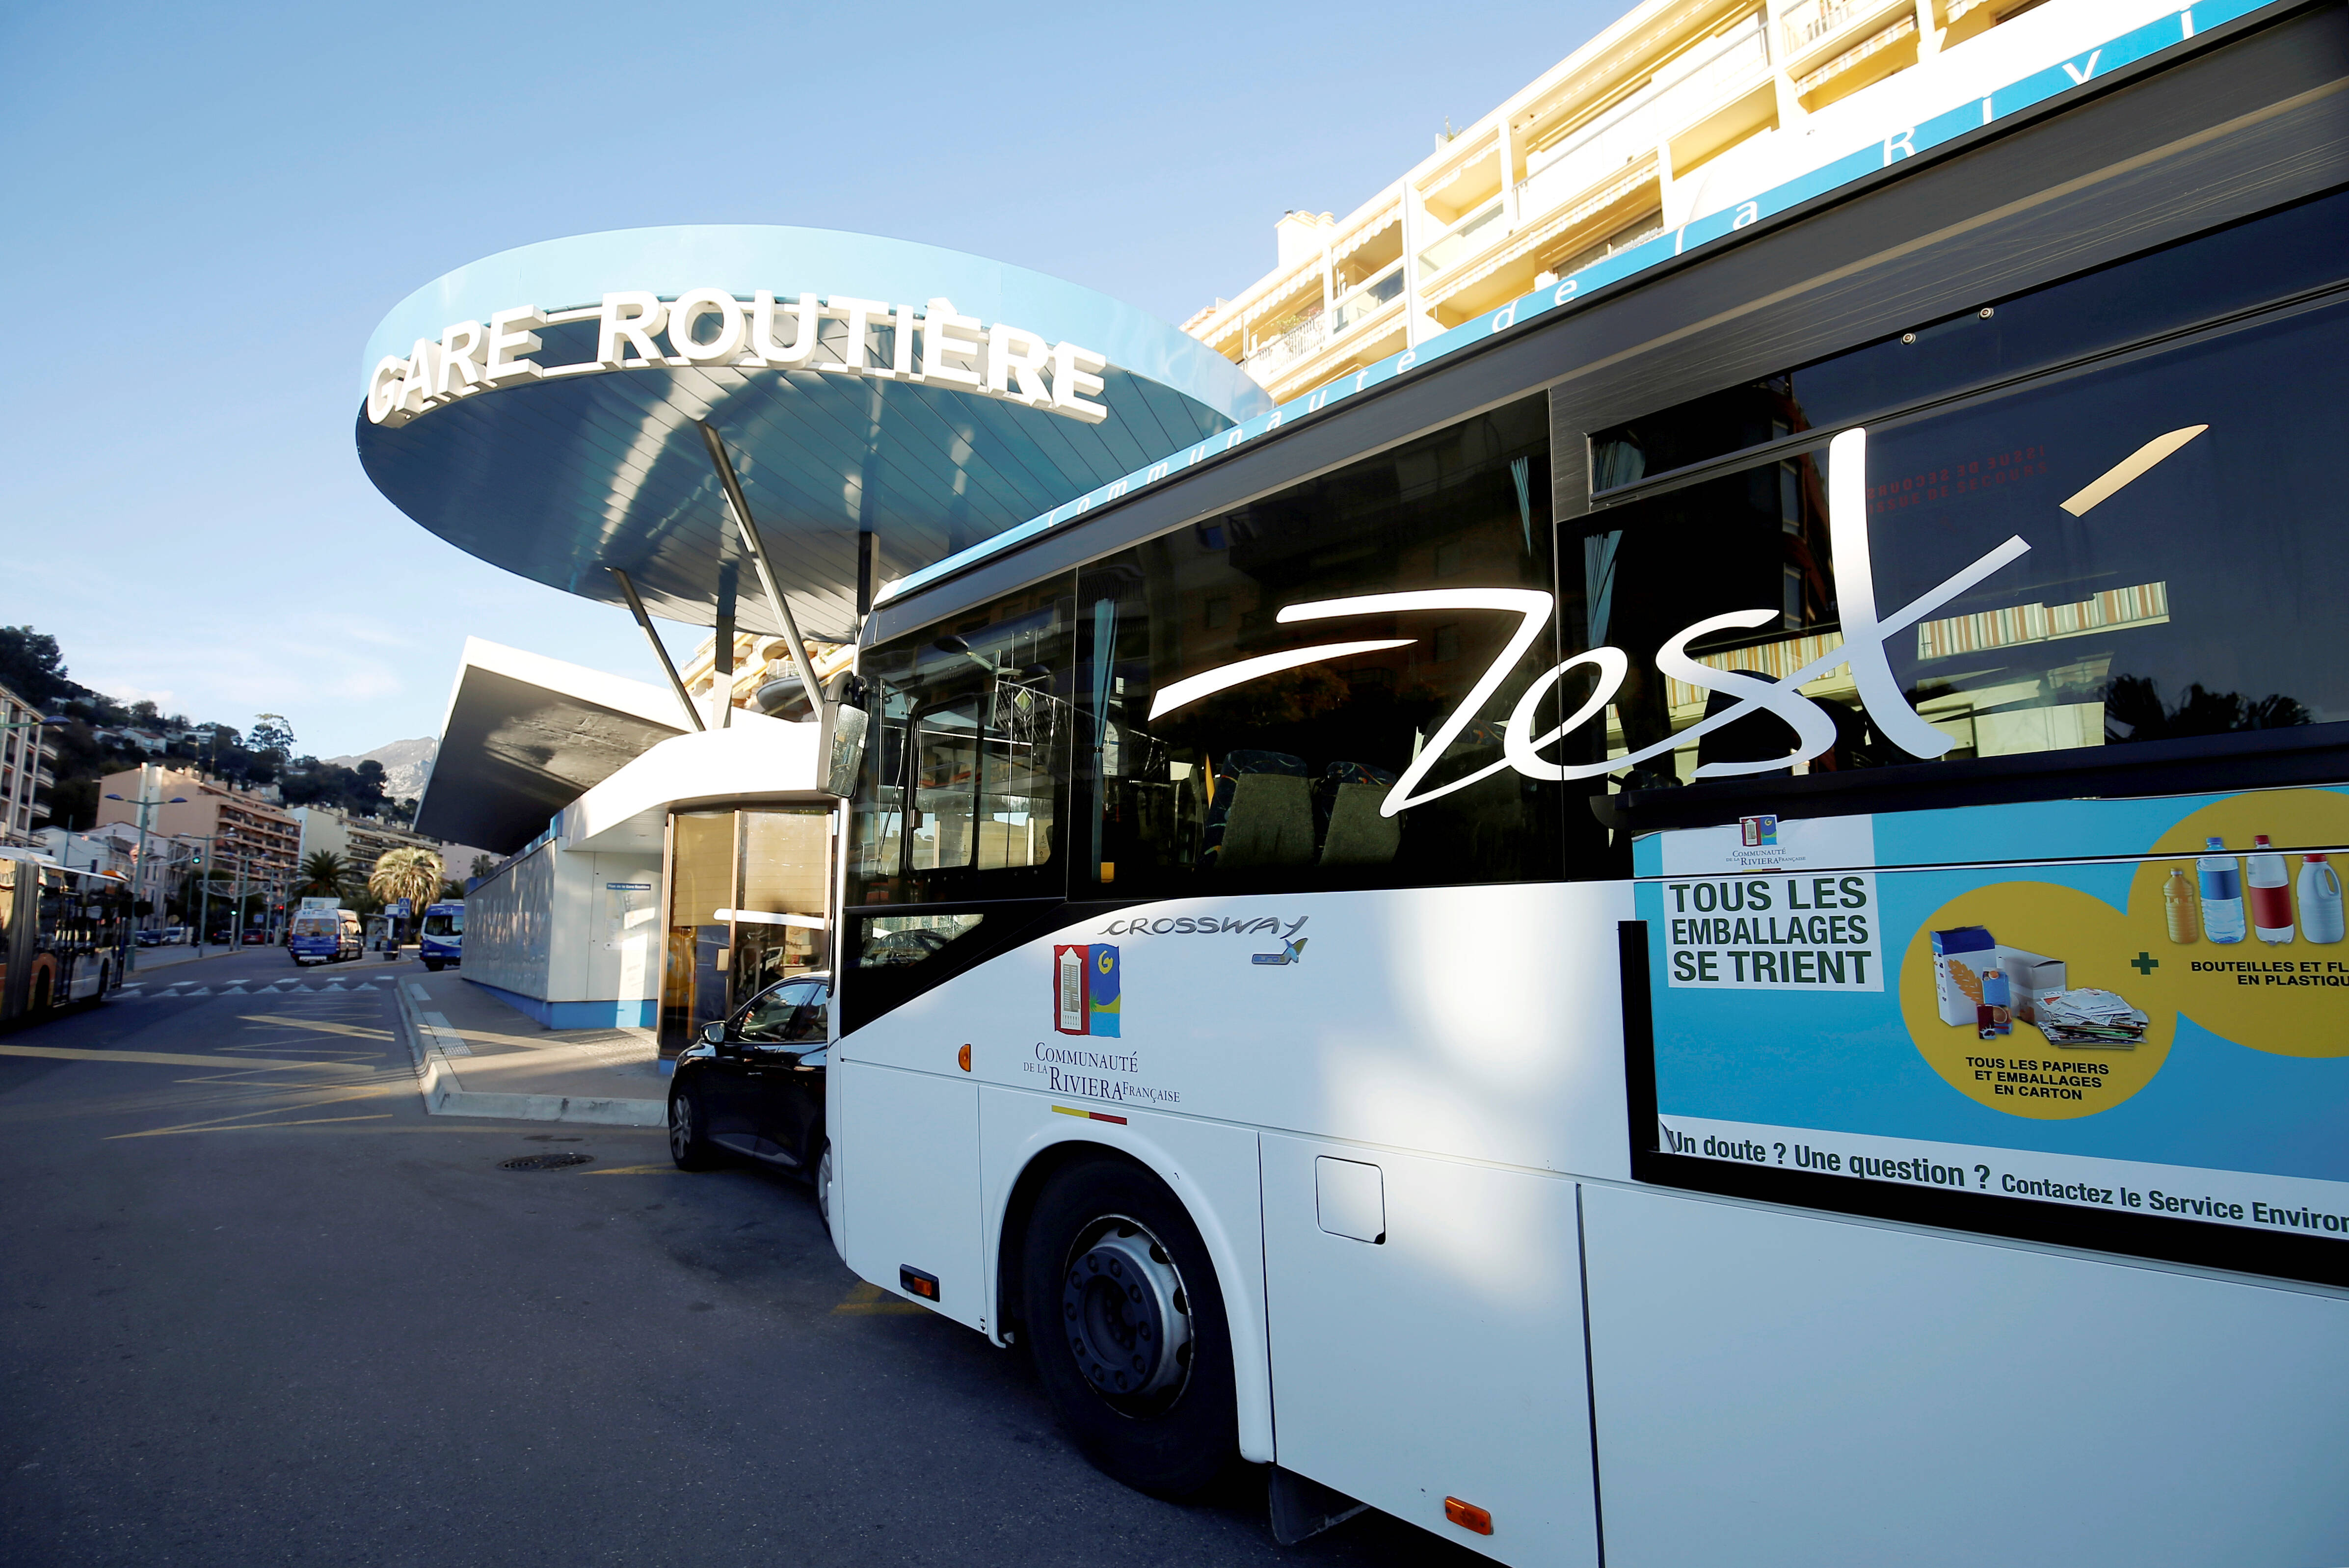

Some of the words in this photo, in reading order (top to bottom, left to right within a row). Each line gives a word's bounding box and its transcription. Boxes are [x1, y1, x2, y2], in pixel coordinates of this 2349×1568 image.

[367, 303, 543, 428] GARE
[597, 287, 1108, 424] ROUTIÈRE
[1048, 345, 1416, 528] Communauté
[1491, 280, 1577, 334] de
[1675, 200, 1758, 256] la
[1869, 494, 1921, 515] ISSUE
[1928, 485, 1949, 501] DE
[1957, 462, 2048, 494] SECOURS
[1740, 857, 1779, 866] RIVIERA
[1669, 880, 1772, 913] TOUS
[1788, 876, 1867, 910] LES
[1097, 915, 1309, 939] CROSSWAY
[1672, 914, 1869, 945] EMBALLAGES
[1673, 951, 1720, 982] SE
[1727, 950, 1872, 984] TRIENT
[2191, 961, 2295, 973] BOUTEILLES
[2300, 962, 2322, 972] ET
[2237, 975, 2259, 985] EN
[2265, 975, 2349, 987] PLASTIQU
[1035, 1042, 1138, 1073] COMMUNAUTÉ
[1965, 1057, 2005, 1069] TOUS
[2009, 1059, 2038, 1071] LES
[2042, 1061, 2109, 1075] PAPIERS
[1023, 1062, 1035, 1072] DE
[1037, 1063, 1048, 1074] LA
[1049, 1066, 1123, 1101] RIVIERA
[1122, 1081, 1180, 1103] FRANÇAISE
[1975, 1070, 1993, 1081] ET
[1997, 1072, 2102, 1088] EMBALLAGES
[1994, 1085, 2014, 1095] EN
[2018, 1086, 2082, 1100] CARTON
[1669, 1131, 1697, 1154] Un
[1703, 1135, 1767, 1162] doute
[1773, 1143, 1787, 1165] ?
[1794, 1145, 1842, 1171] Une
[1849, 1154, 1965, 1187] question
[1974, 1165, 1991, 1189] ?
[2001, 1173, 2114, 1205] Contactez
[2120, 1187, 2141, 1208] le
[2148, 1190, 2244, 1221] Service
